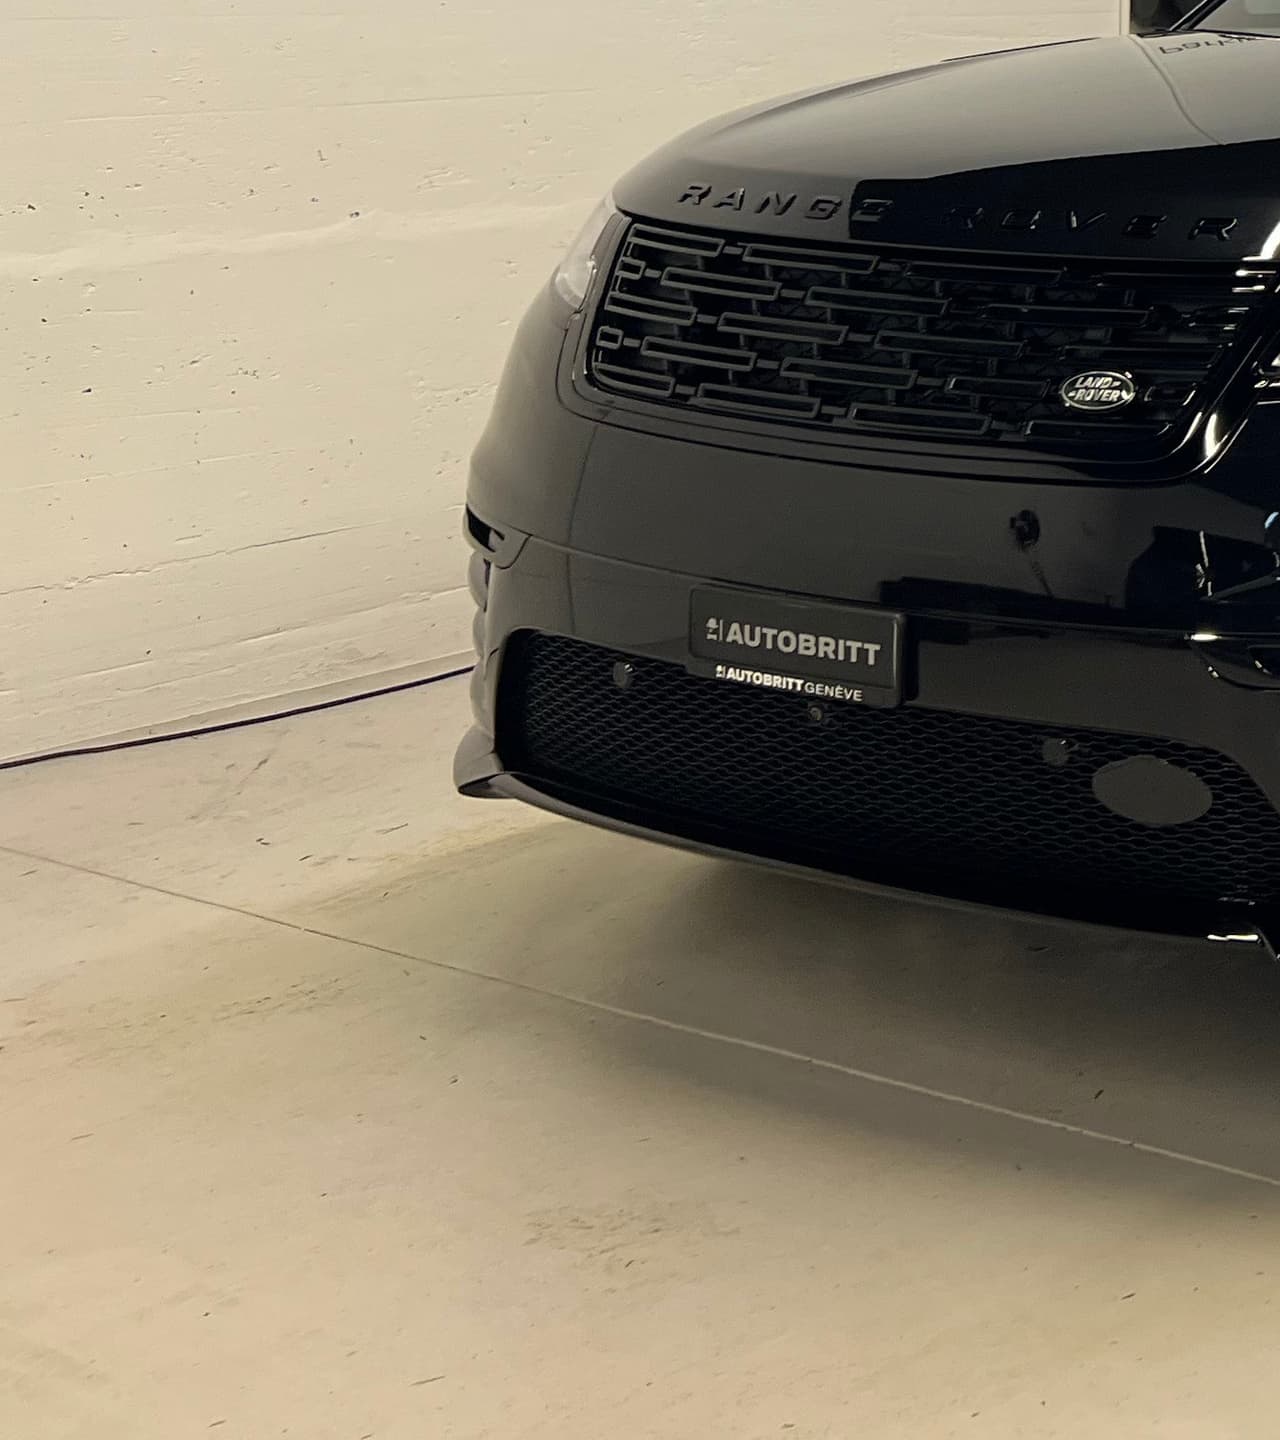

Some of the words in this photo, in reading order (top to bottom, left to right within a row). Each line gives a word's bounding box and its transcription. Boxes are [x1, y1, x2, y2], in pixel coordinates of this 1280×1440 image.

[677, 183, 894, 223] RANGE
[949, 207, 1240, 241] ROVER
[725, 622, 882, 666] AUTOBRITT
